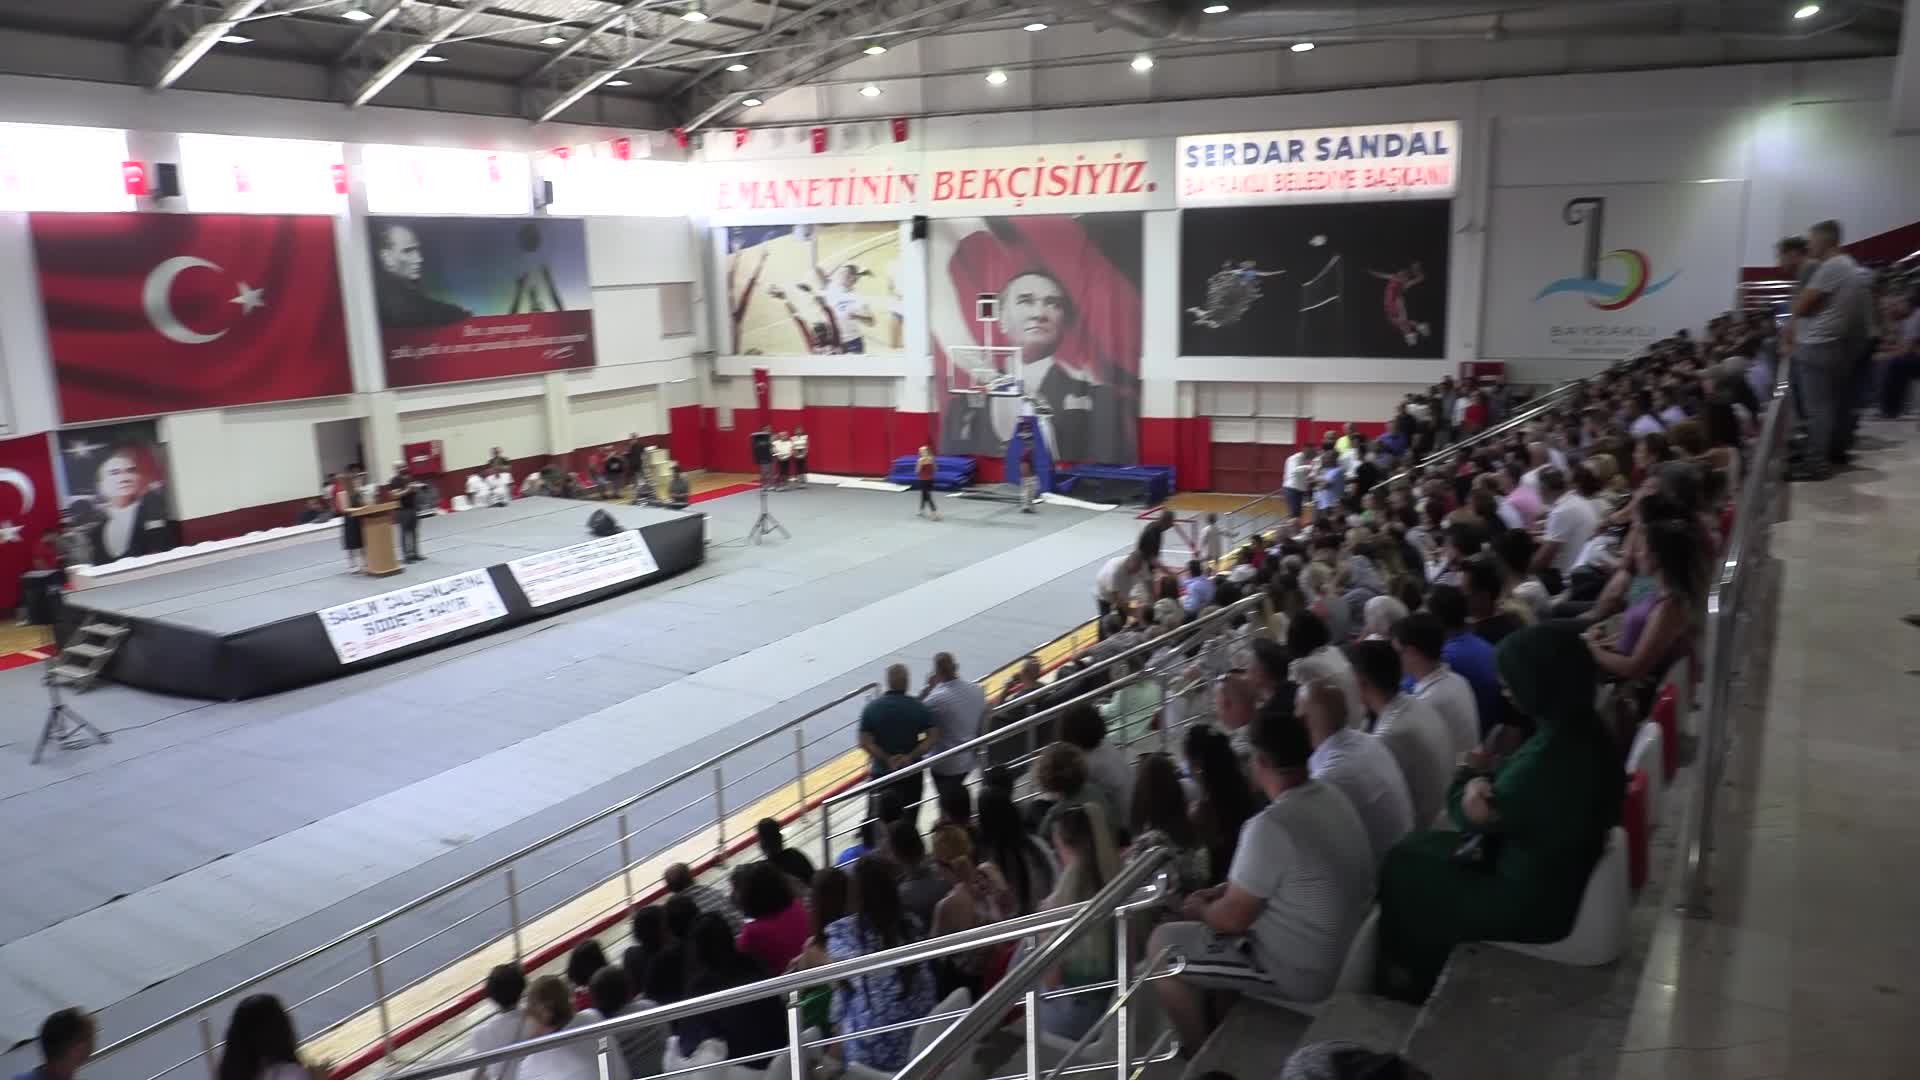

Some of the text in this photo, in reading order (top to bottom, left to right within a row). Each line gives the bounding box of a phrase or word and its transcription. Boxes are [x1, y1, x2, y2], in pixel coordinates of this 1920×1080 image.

[1185, 131, 1448, 168] SERDAR SANDAL
[718, 153, 1158, 210] EMANETİNİN BEKÇİSİYİZ.
